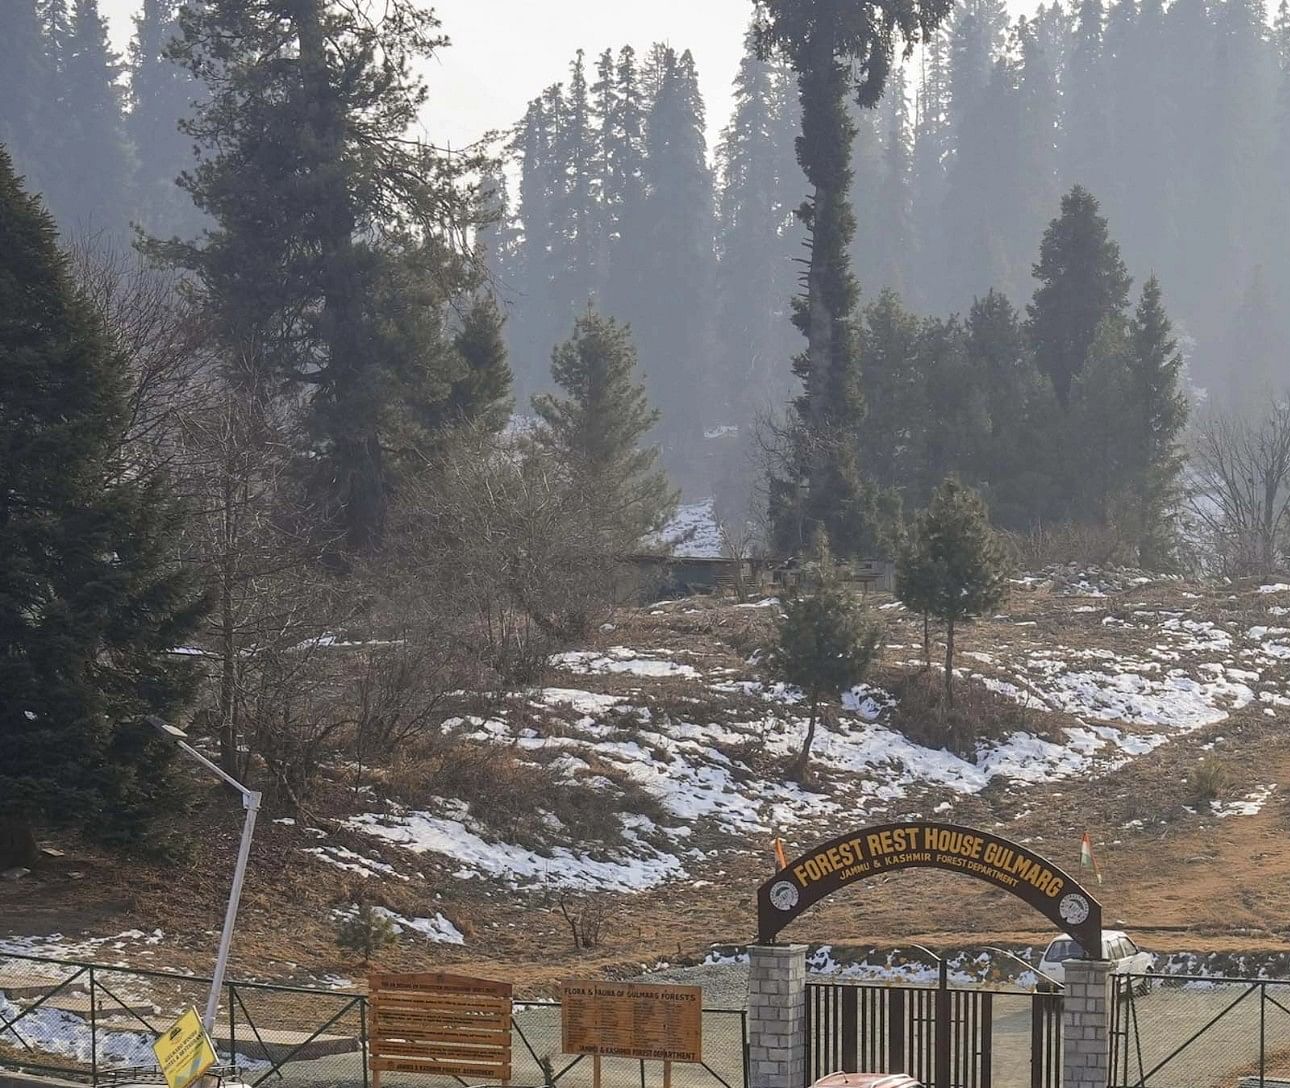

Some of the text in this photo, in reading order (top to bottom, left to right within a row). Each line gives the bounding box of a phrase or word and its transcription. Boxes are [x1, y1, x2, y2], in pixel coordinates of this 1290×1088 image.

[793, 827, 1063, 898] FOREST REST HOUSE GULMARG
[839, 852, 1018, 887] JAMMU & KASHMIR FOREST DEPARTMENT
[564, 987, 585, 995] FLORA
[661, 993, 696, 1002] FORESTS
